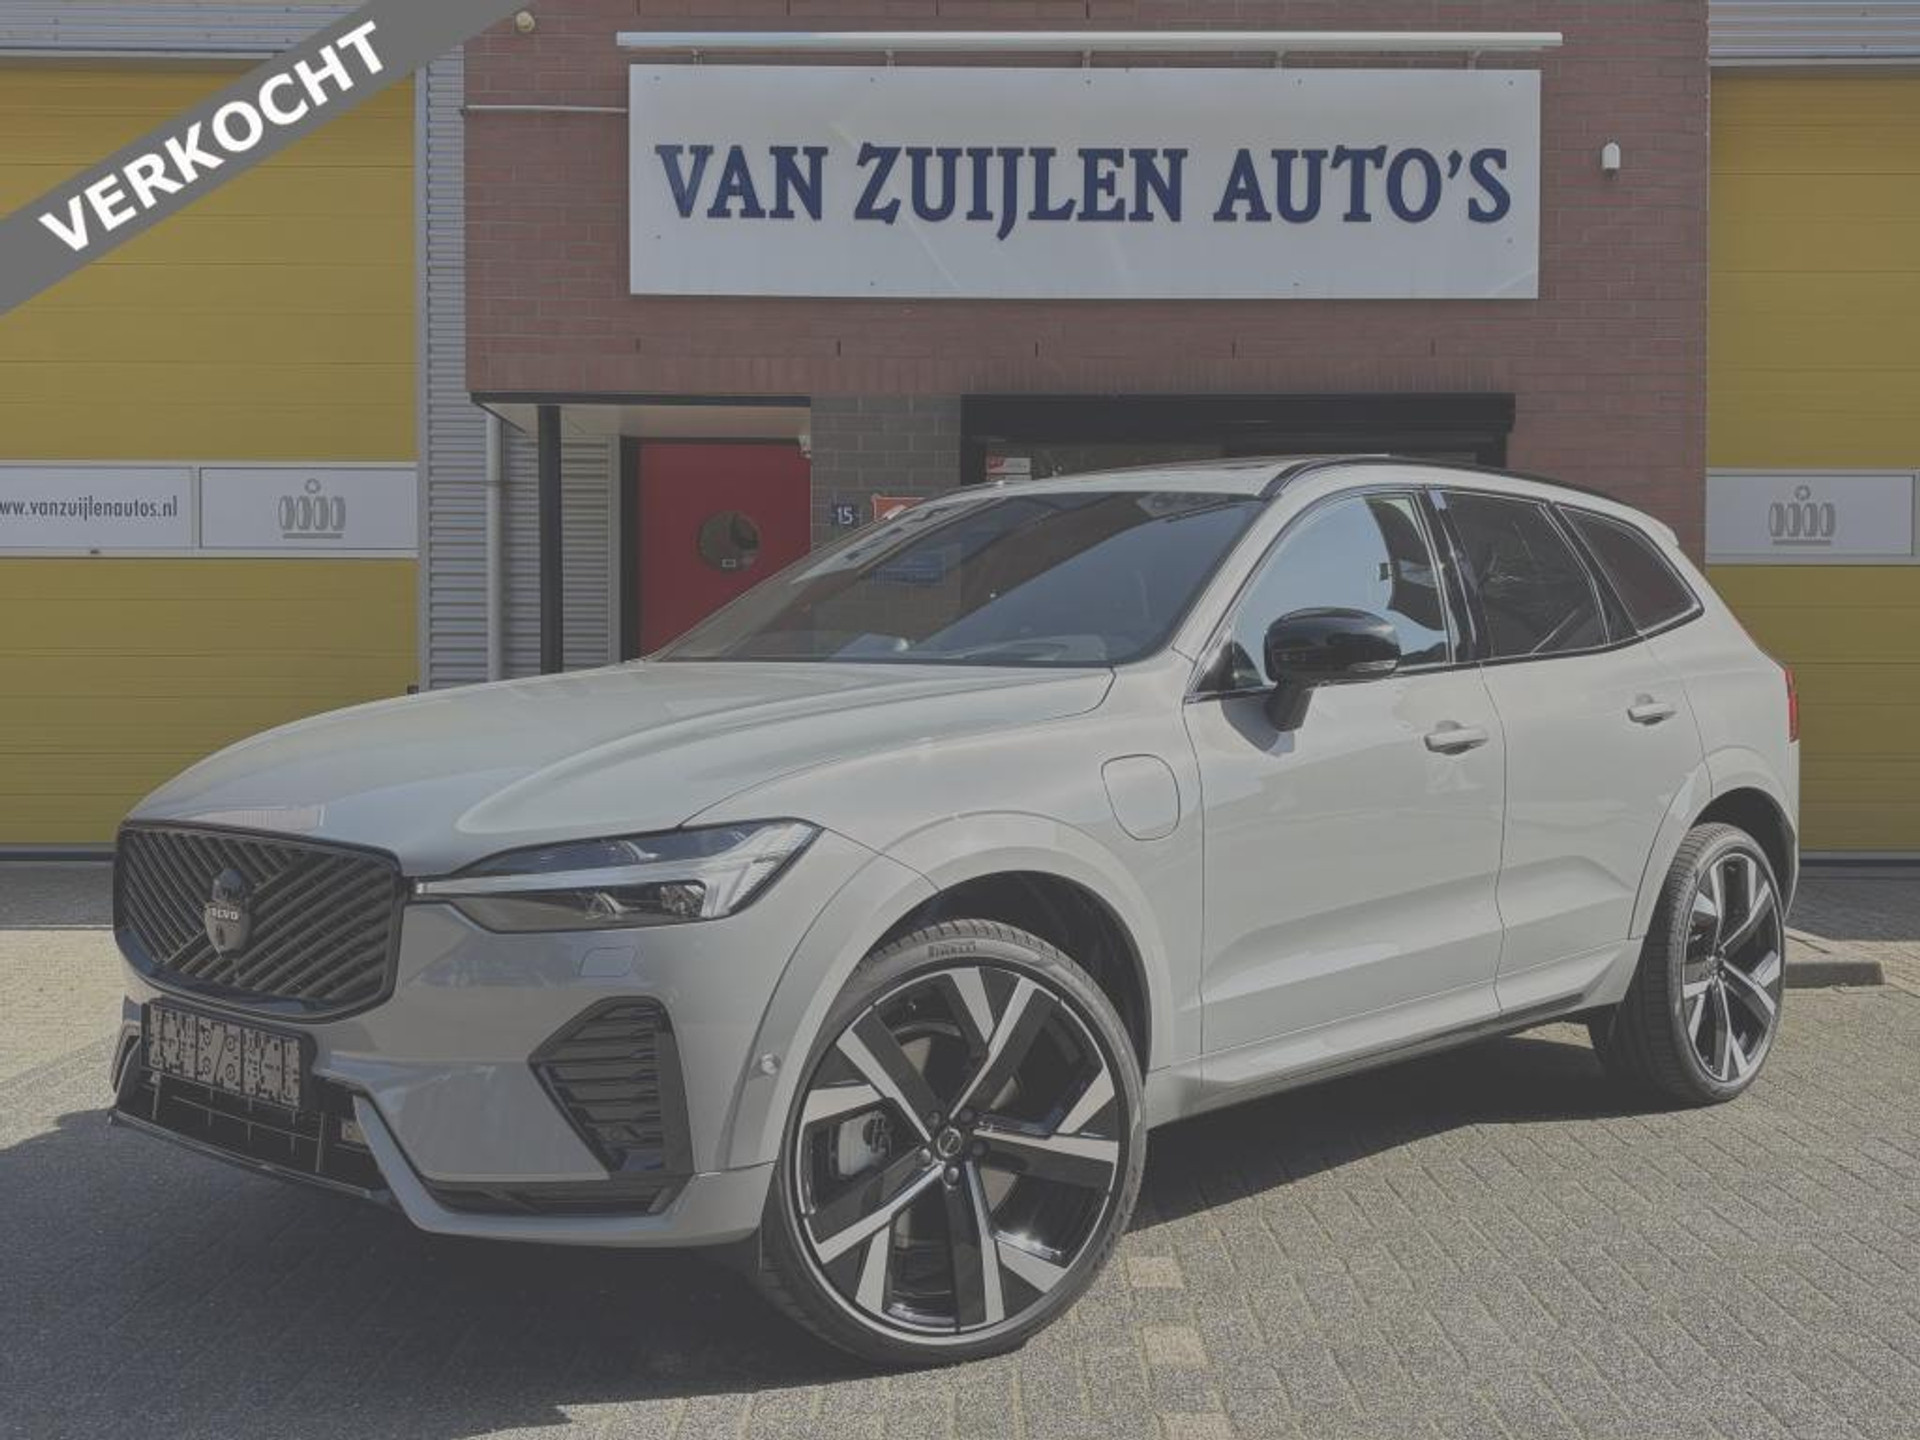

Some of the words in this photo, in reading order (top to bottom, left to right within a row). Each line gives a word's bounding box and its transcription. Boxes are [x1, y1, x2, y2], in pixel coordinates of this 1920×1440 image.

[655, 145, 829, 220] VAN
[854, 143, 1189, 241] ZUIJLEN
[1213, 145, 1511, 223] AUTO'S
[838, 506, 853, 525] 15
